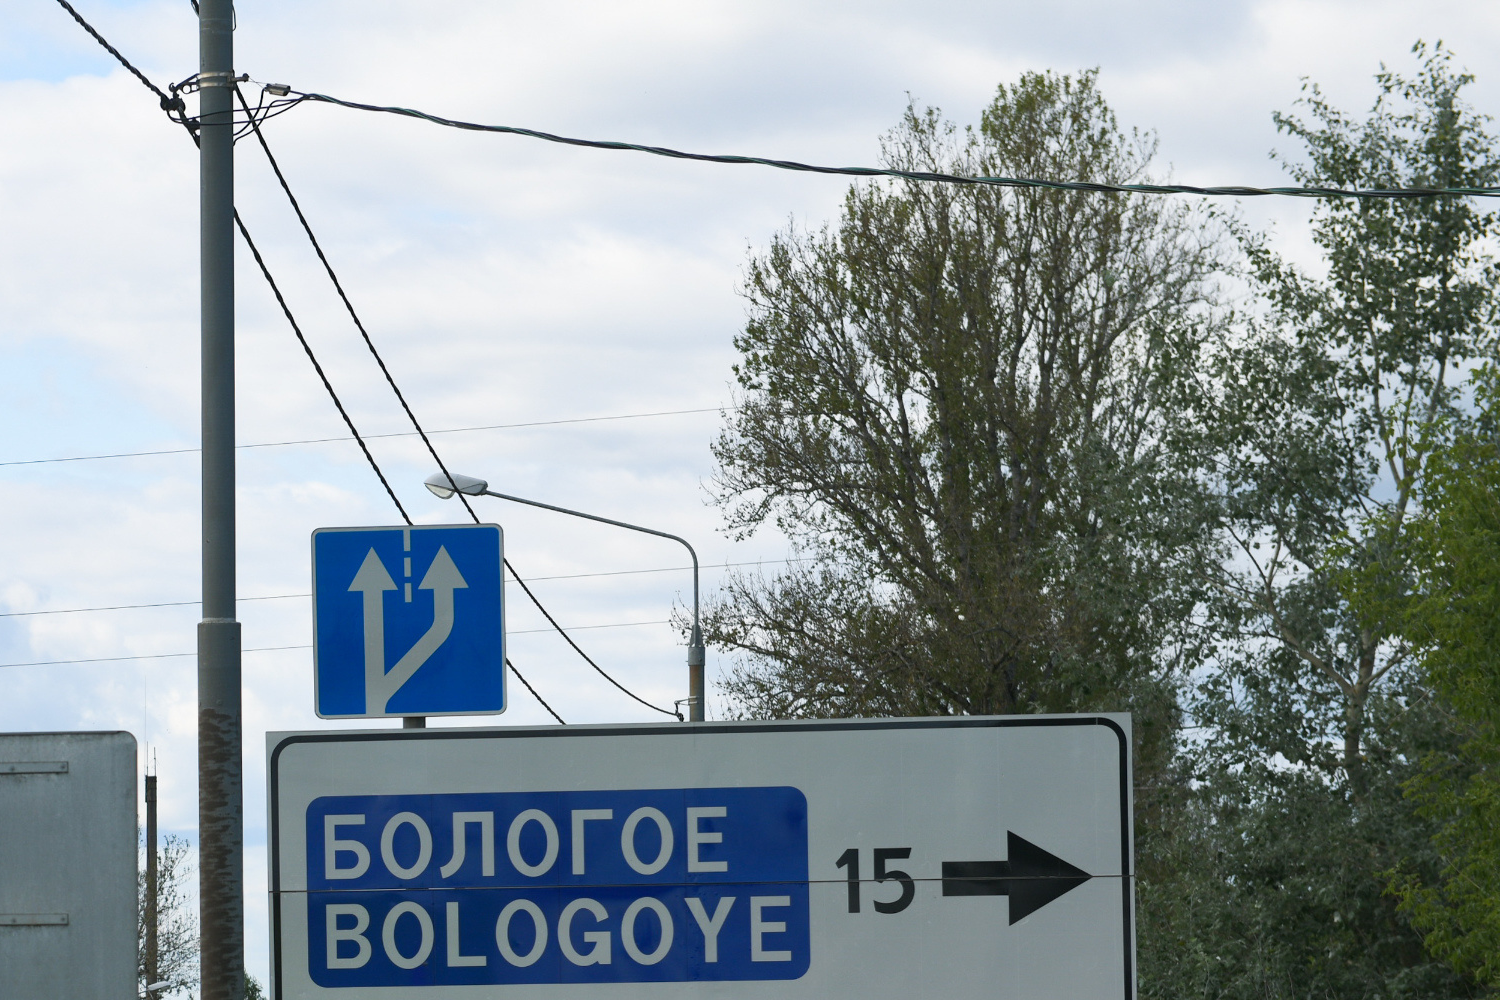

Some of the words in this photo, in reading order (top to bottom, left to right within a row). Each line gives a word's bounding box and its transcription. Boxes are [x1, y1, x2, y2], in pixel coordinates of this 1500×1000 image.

[322, 805, 729, 881] БОЛОГОЕ
[835, 846, 916, 915] 15
[324, 895, 793, 970] BOLOGOYE
